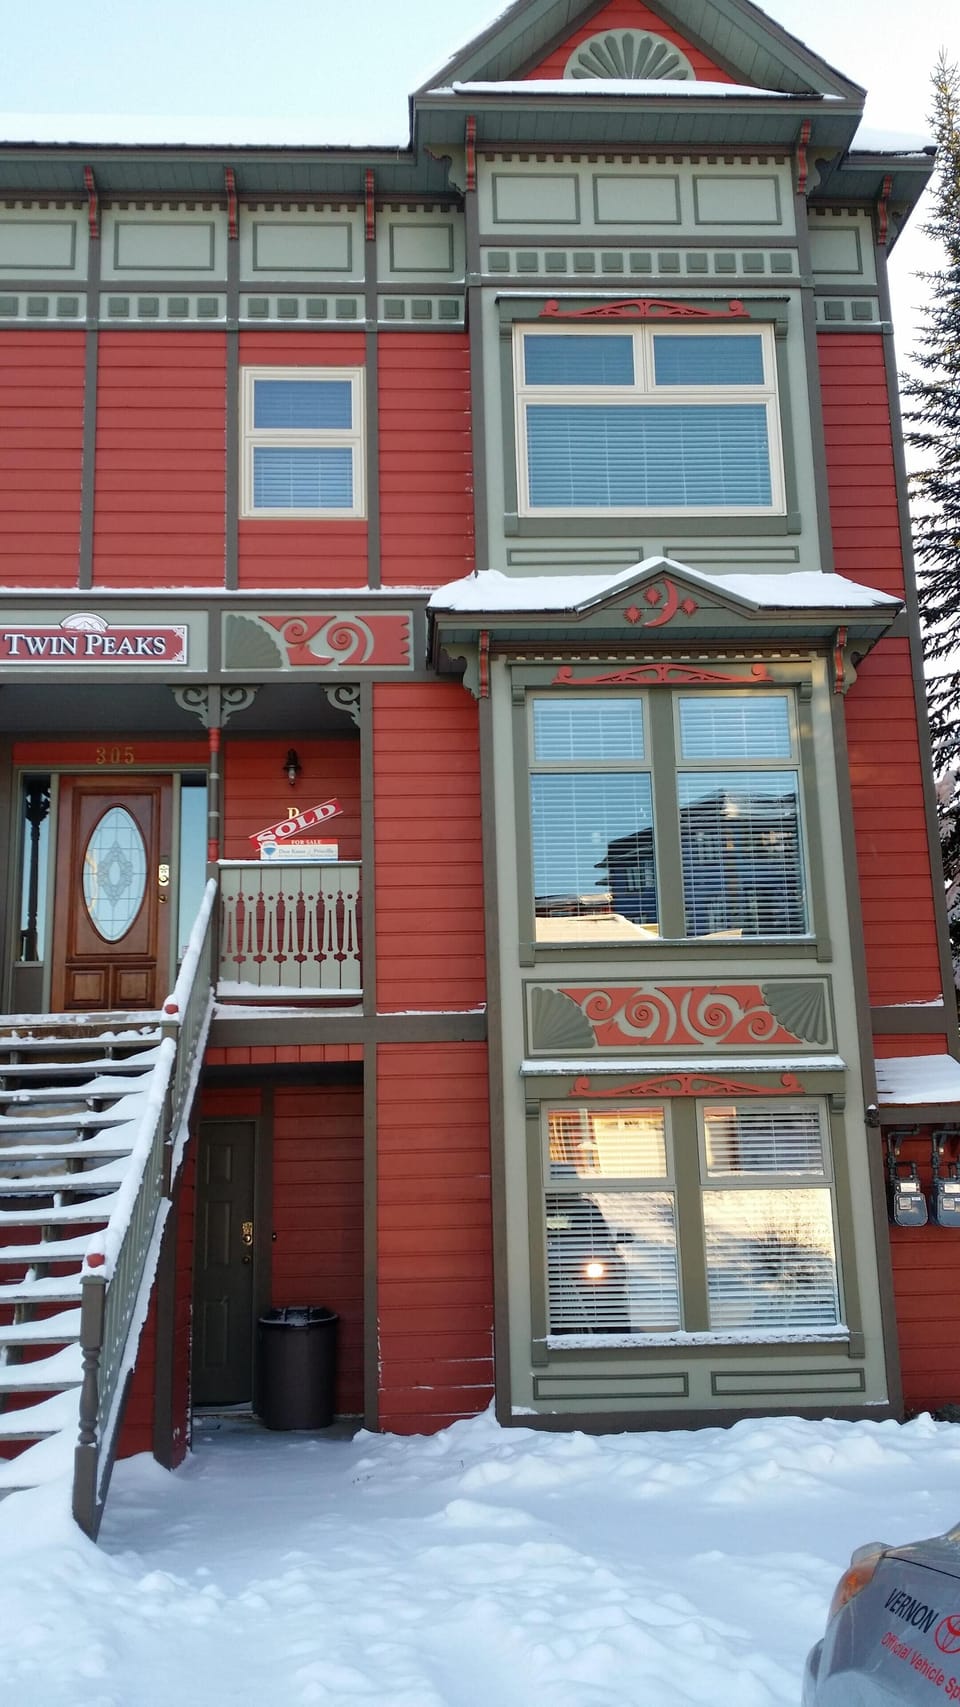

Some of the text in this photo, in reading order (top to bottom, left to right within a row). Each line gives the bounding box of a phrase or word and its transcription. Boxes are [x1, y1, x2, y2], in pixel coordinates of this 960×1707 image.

[4, 633, 167, 656] TWIN PEAKS
[95, 746, 135, 765] 305
[256, 804, 336, 846] SOLD
[884, 1587, 940, 1634] VERNON
[880, 1631, 960, 1703] Official Vehicle Sp
